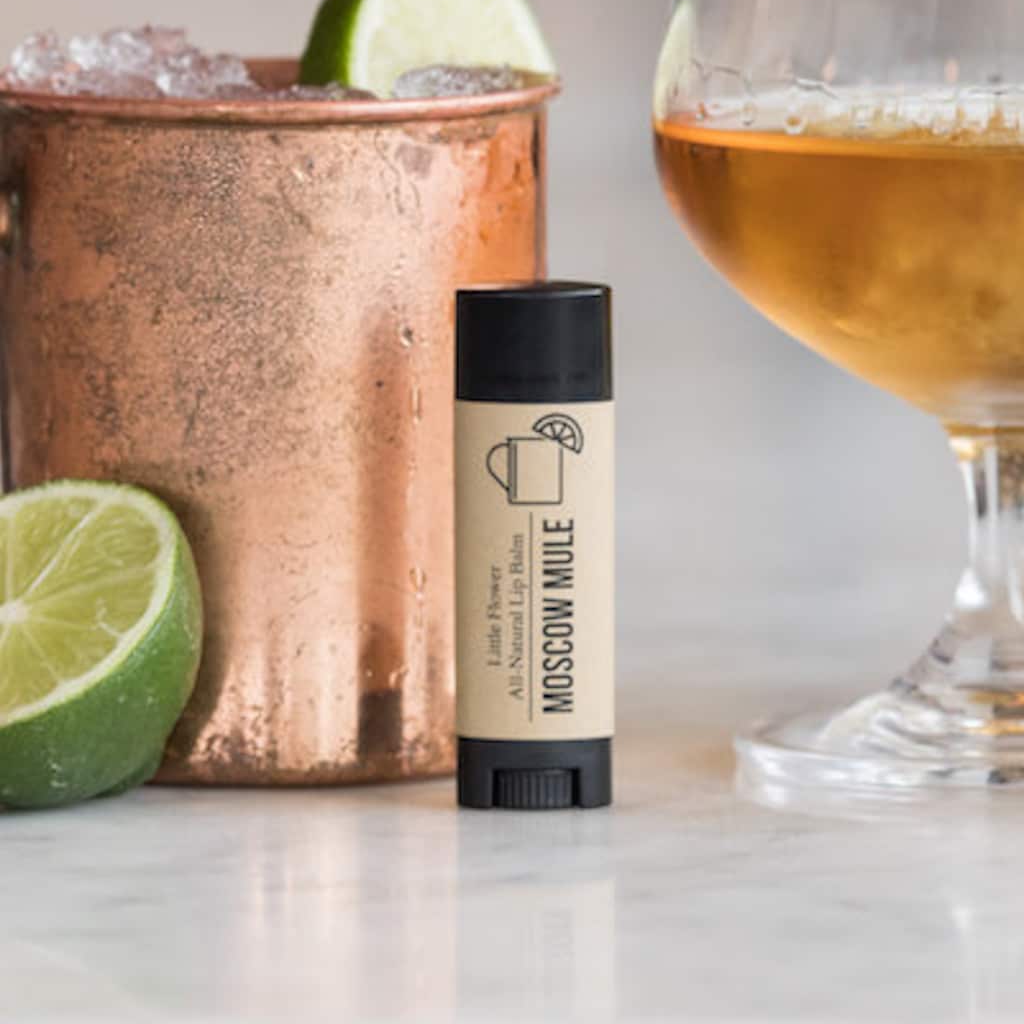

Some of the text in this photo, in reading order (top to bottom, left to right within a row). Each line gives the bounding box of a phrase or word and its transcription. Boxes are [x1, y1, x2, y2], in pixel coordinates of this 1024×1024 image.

[487, 566, 502, 667] Little Flower
[508, 533, 528, 701] All-Natural Lip Balm
[542, 519, 574, 713] MOSCOW MULE
